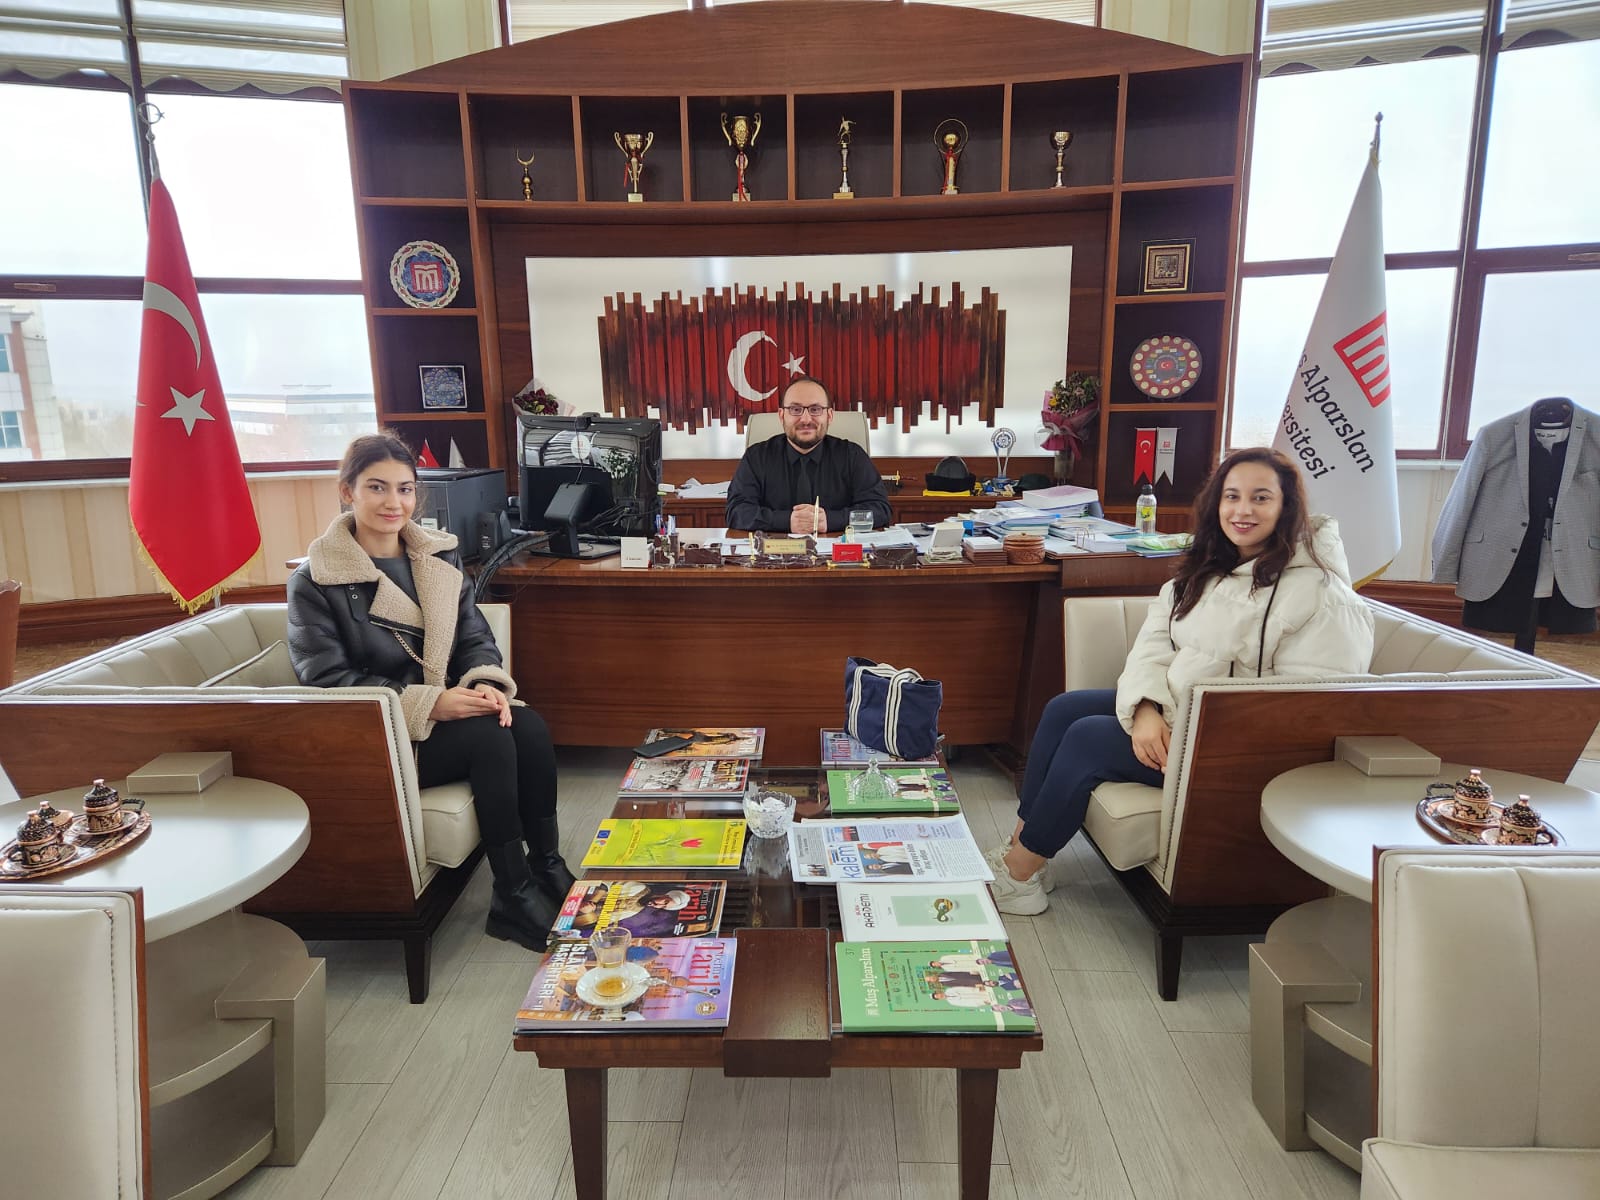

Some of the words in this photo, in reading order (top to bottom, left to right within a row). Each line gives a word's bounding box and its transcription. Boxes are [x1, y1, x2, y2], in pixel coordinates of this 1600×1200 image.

[1282, 402, 1336, 480] ersitesi
[1300, 364, 1375, 473] Alparslan
[836, 845, 862, 879] kalem
[686, 942, 725, 994] Tarih
[859, 947, 878, 988] Alparslan
[865, 988, 880, 1008] Muş
